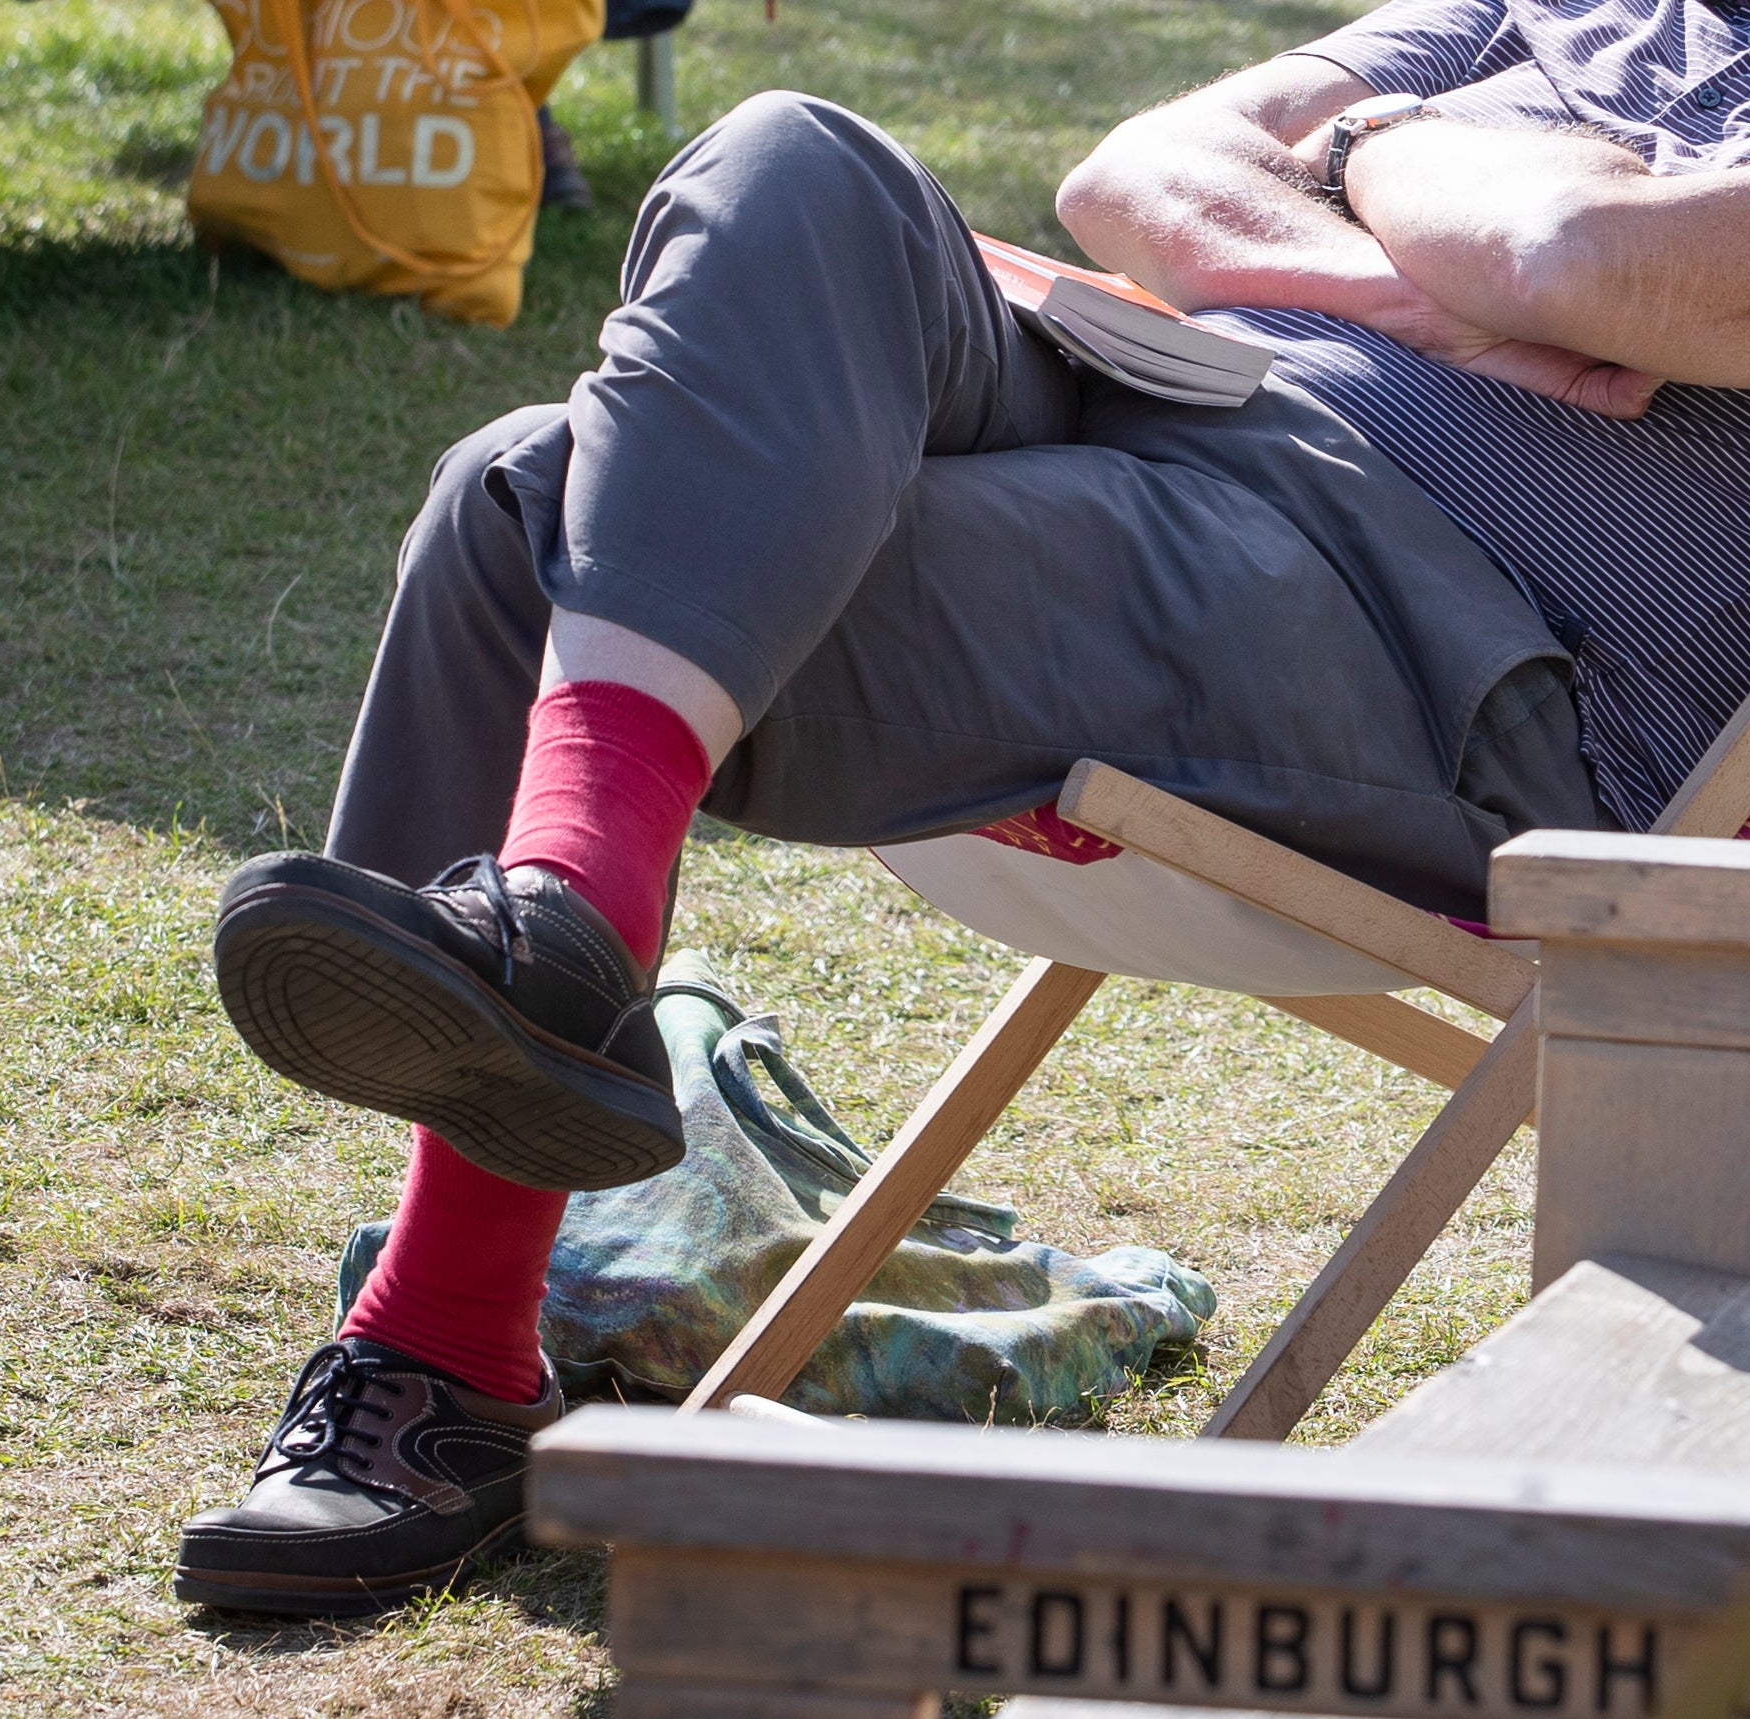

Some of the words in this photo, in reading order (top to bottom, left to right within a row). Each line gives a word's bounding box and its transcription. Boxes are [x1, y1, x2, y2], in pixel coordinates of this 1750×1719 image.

[374, 54, 489, 108] THE
[201, 103, 477, 188] WORLD
[957, 1585, 1660, 1718] EDINBURGH
